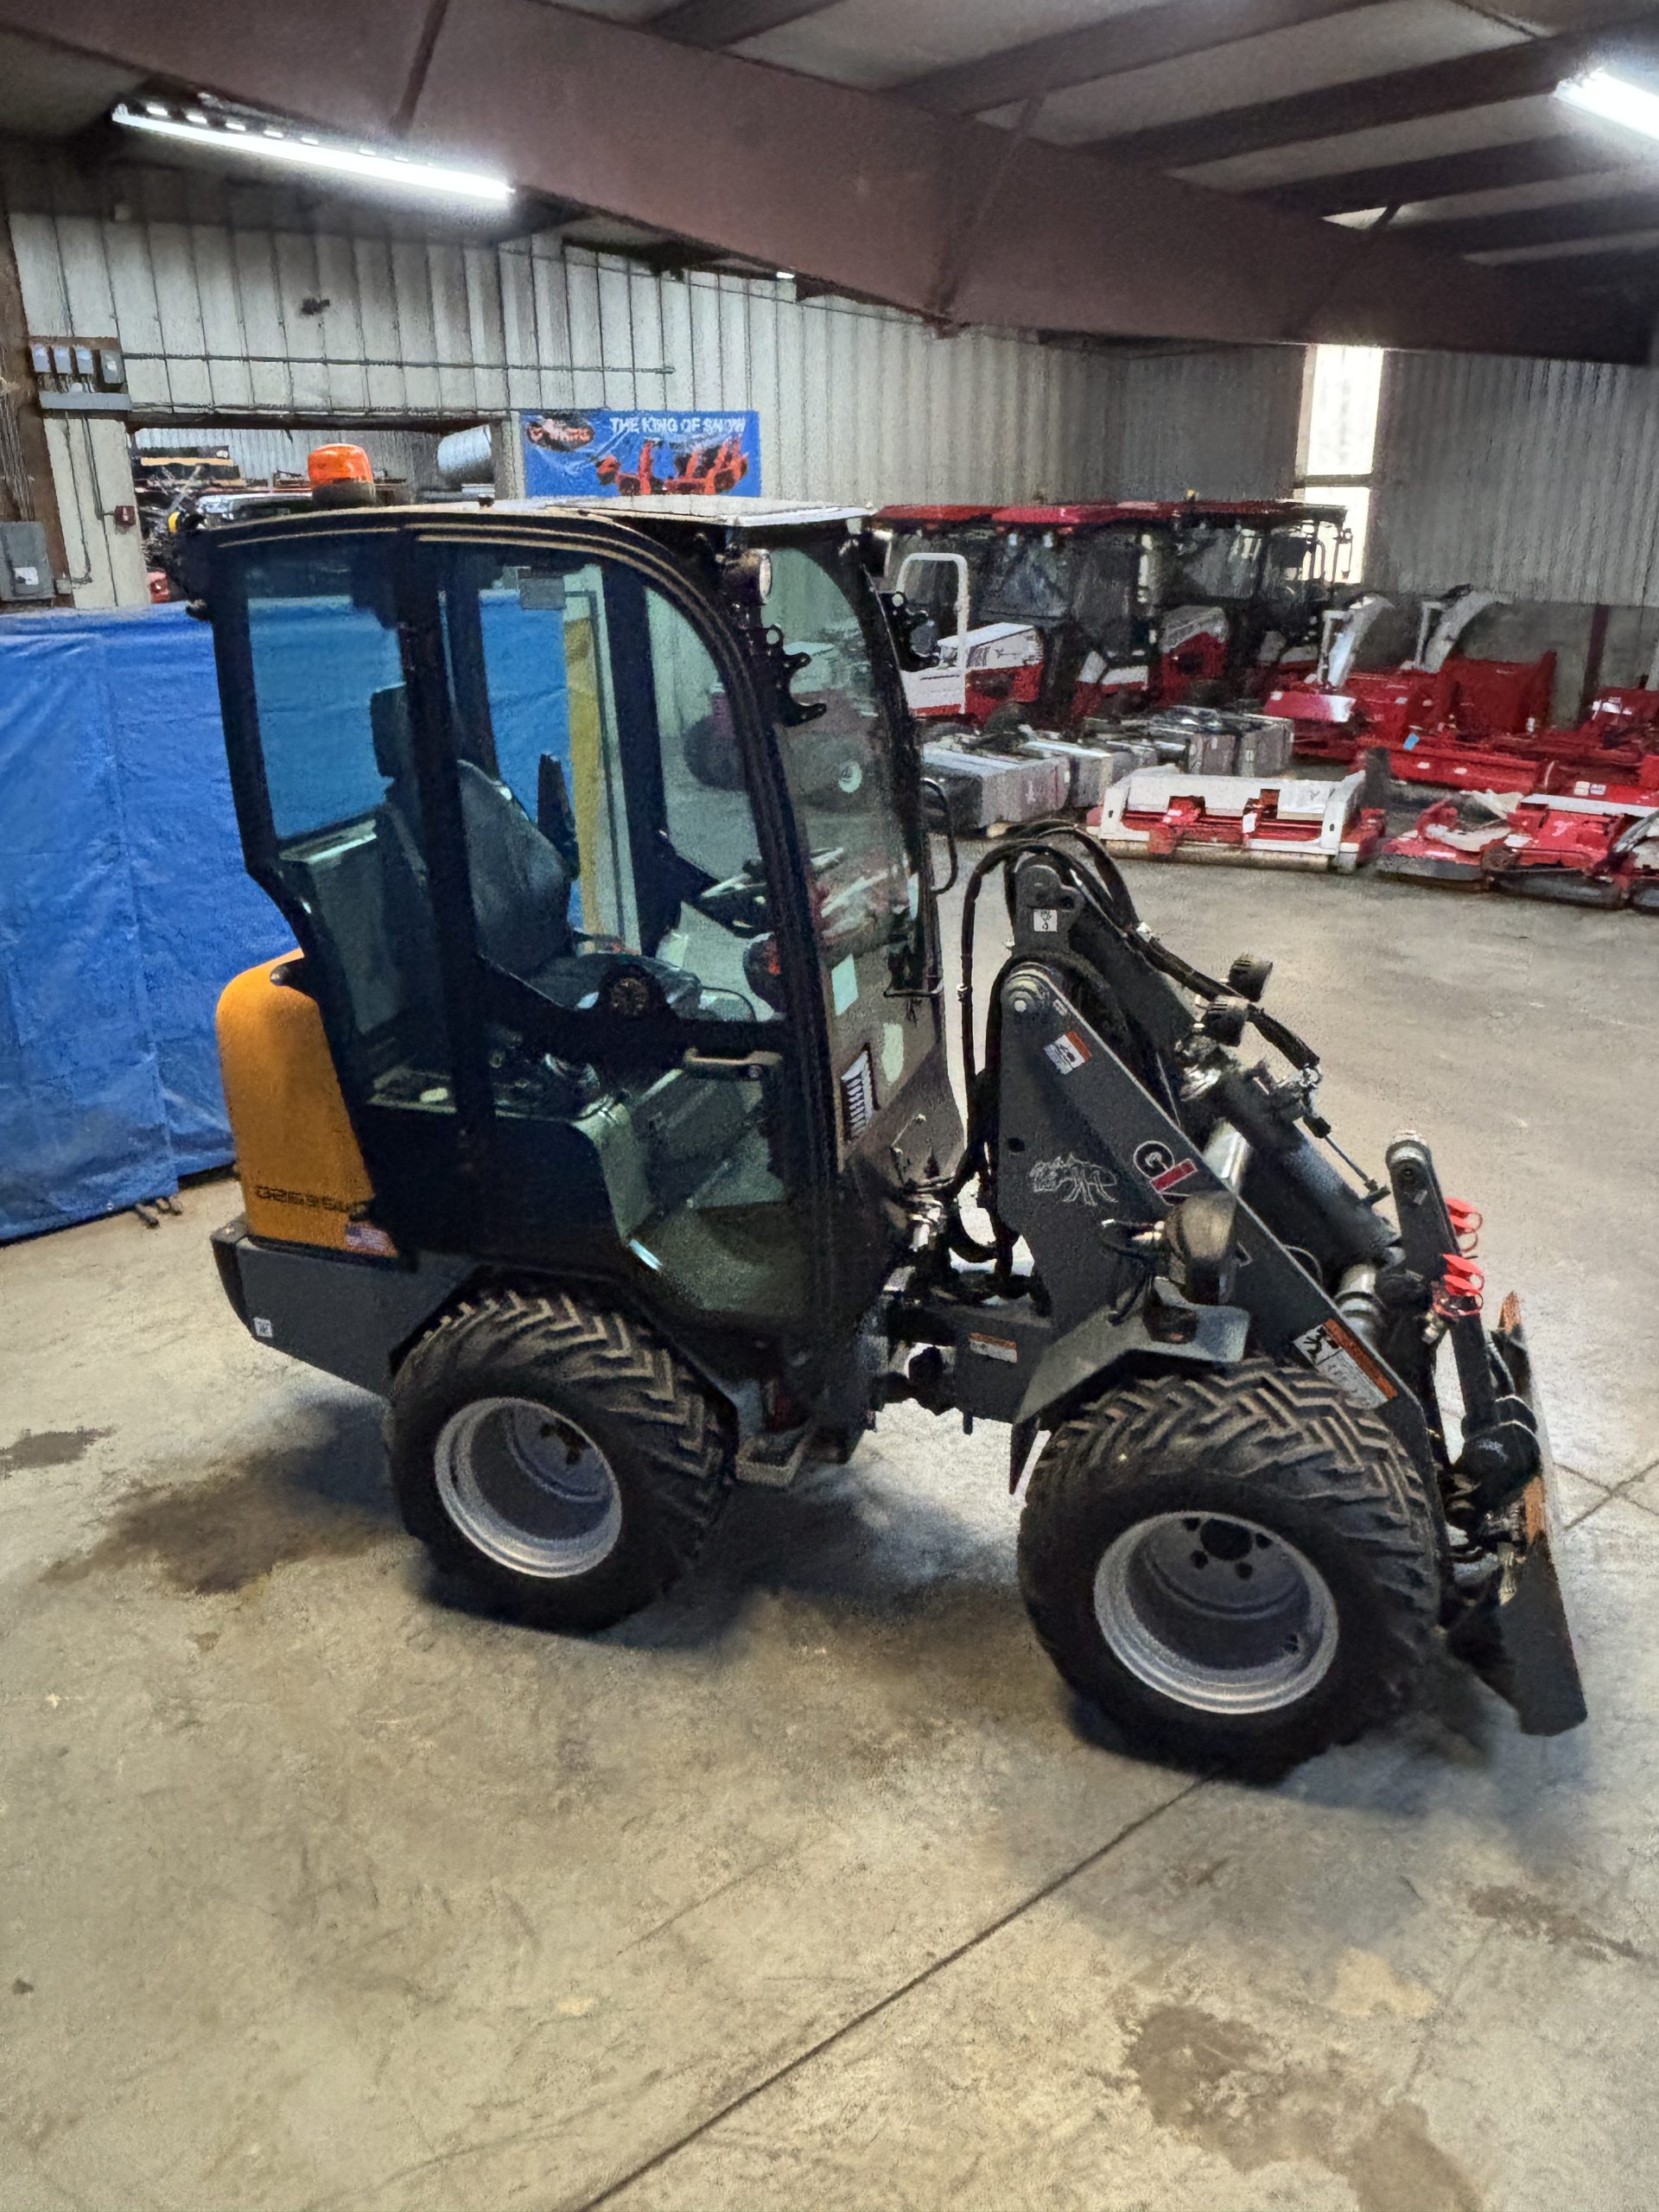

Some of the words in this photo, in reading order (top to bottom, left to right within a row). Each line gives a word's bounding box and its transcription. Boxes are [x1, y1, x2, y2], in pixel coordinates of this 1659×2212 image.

[609, 417, 639, 432] THE
[641, 417, 678, 432] KING
[681, 417, 701, 432] OF
